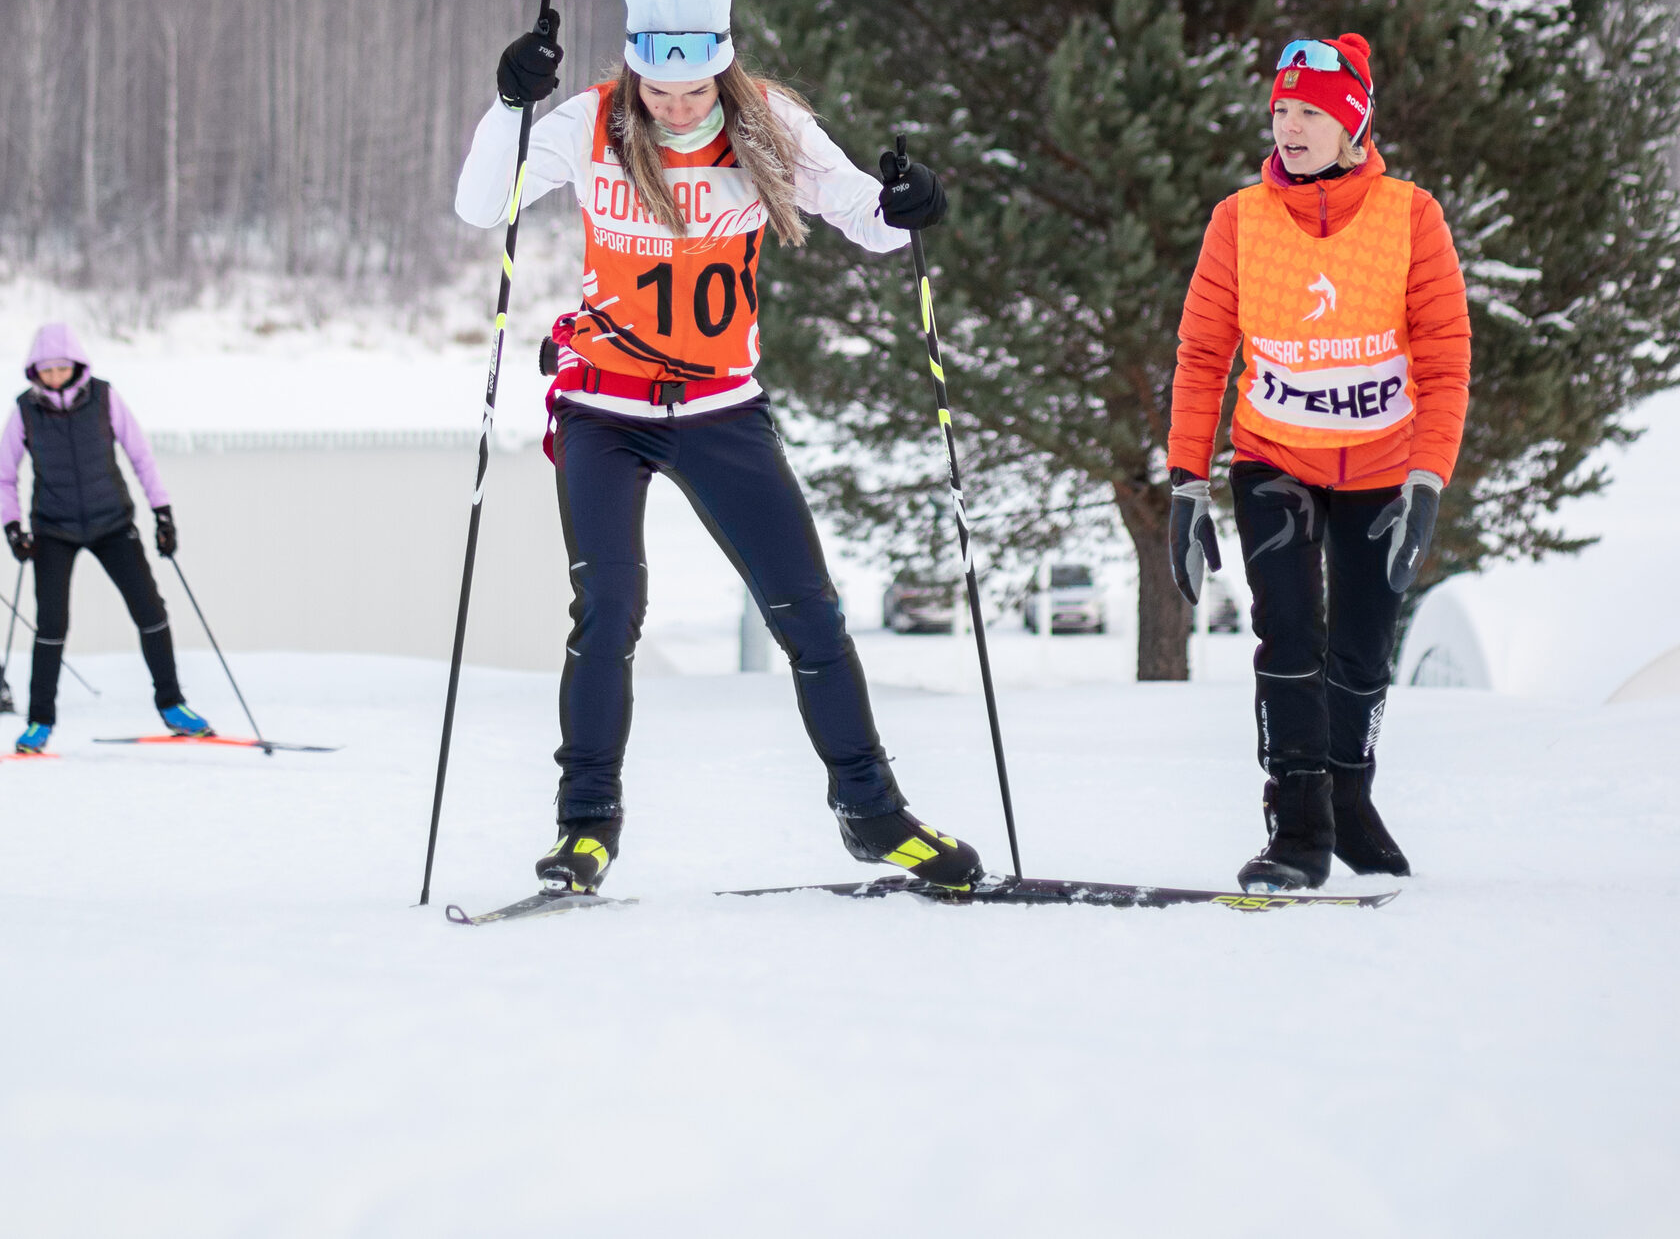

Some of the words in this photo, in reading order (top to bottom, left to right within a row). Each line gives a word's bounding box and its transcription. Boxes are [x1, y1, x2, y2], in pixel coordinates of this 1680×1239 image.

[1345, 94, 1366, 115] BOSCO
[594, 176, 711, 225] CORAC
[593, 227, 632, 254] SPORT
[636, 237, 673, 257] CLUB
[637, 262, 737, 337] 10
[1308, 337, 1361, 361] SPORT
